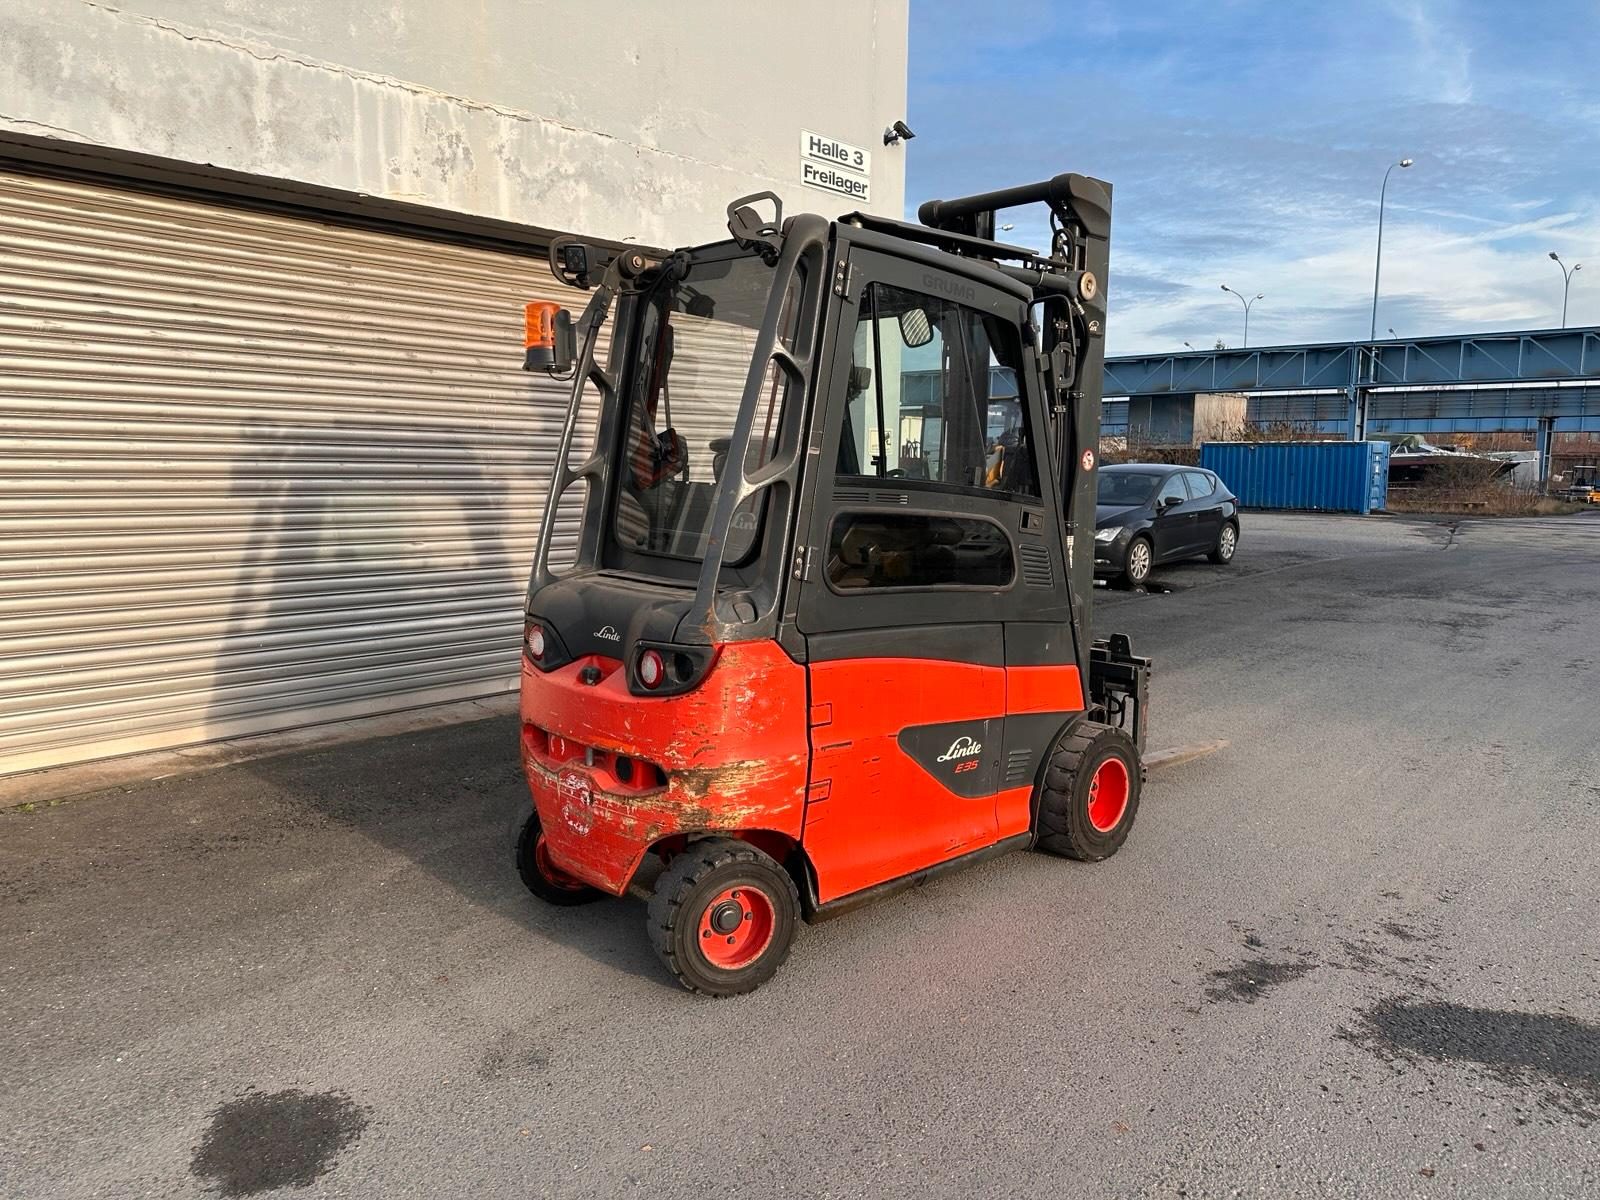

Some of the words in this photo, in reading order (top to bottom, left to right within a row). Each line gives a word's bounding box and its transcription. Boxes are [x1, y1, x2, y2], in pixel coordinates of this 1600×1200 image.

[809, 136, 849, 161] Halle
[853, 151, 864, 166] 3
[804, 164, 868, 194] Freilager
[593, 625, 621, 642] Linde
[936, 736, 982, 762] Linde
[954, 760, 979, 774] E35
